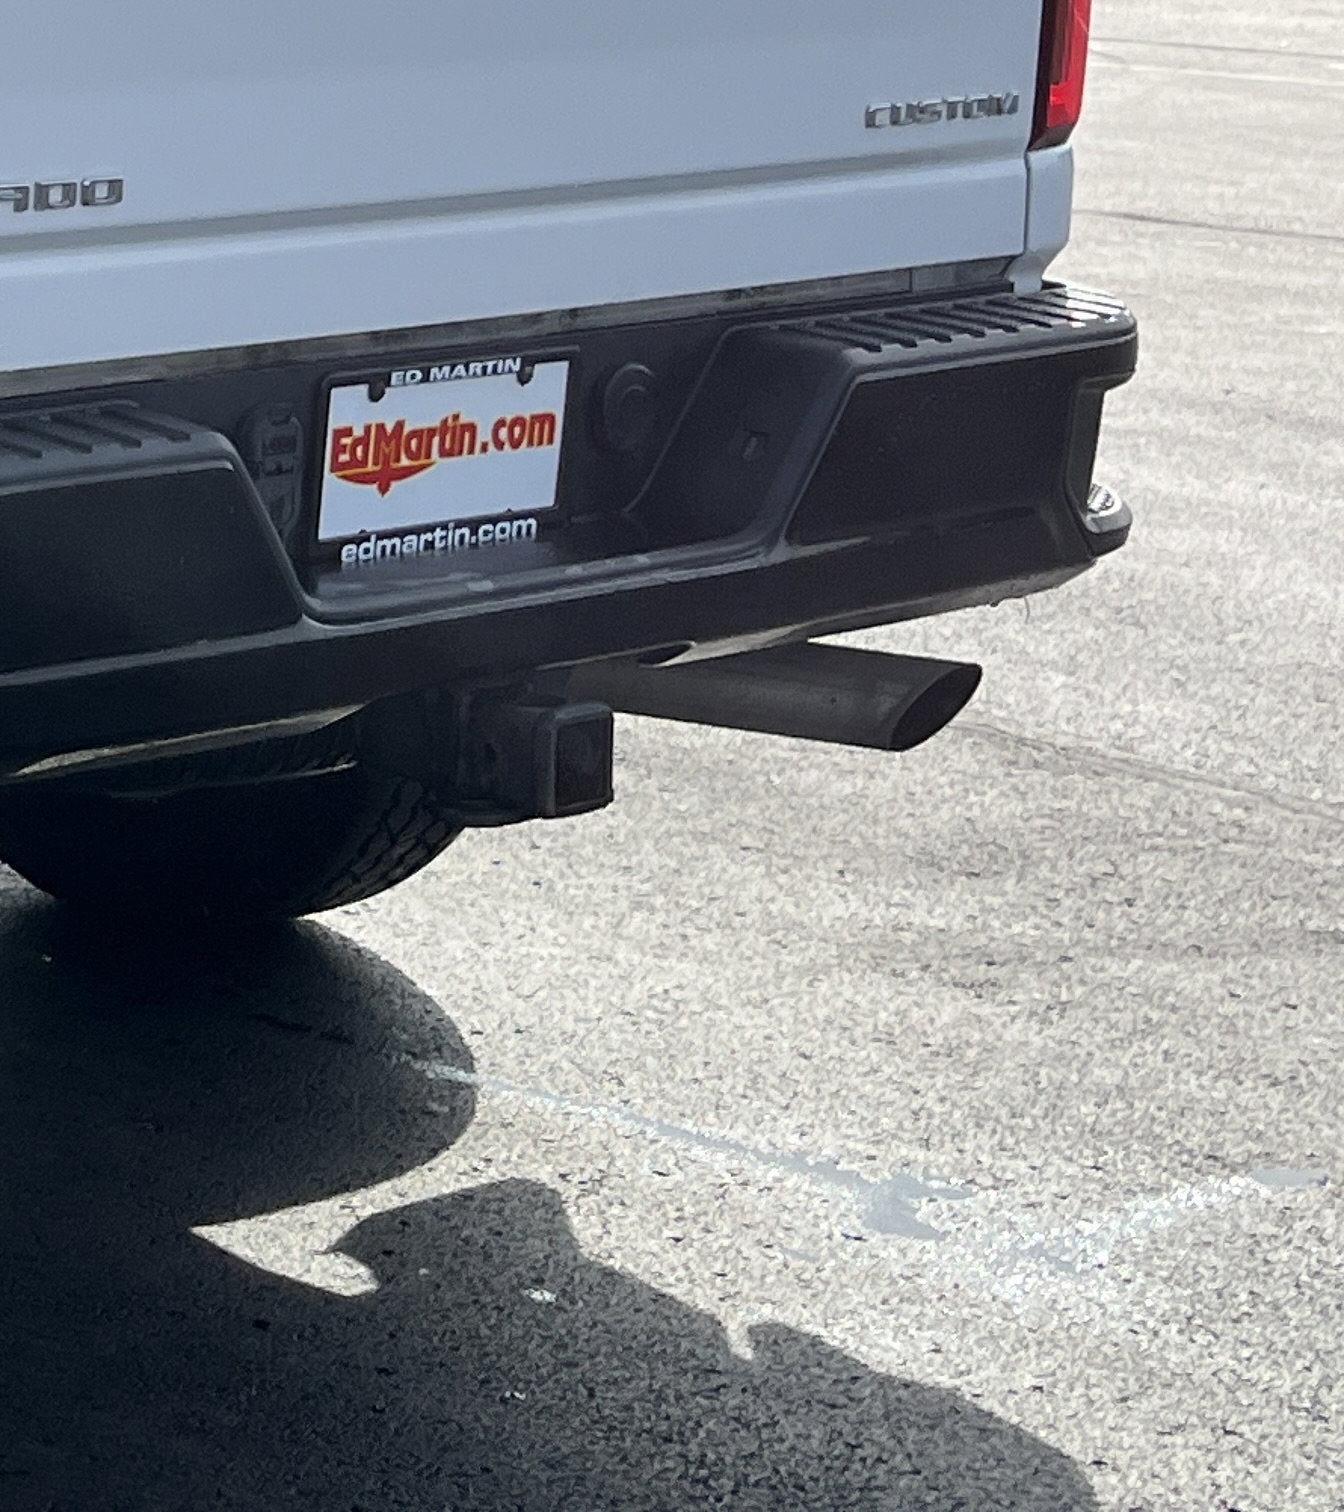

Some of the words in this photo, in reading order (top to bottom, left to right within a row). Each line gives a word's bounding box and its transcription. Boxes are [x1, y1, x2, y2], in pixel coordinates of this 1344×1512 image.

[864, 91, 1020, 129] CUSTOM
[390, 369, 423, 386] ED
[429, 357, 522, 382] MARTIN
[340, 516, 538, 564] edmartin.com
